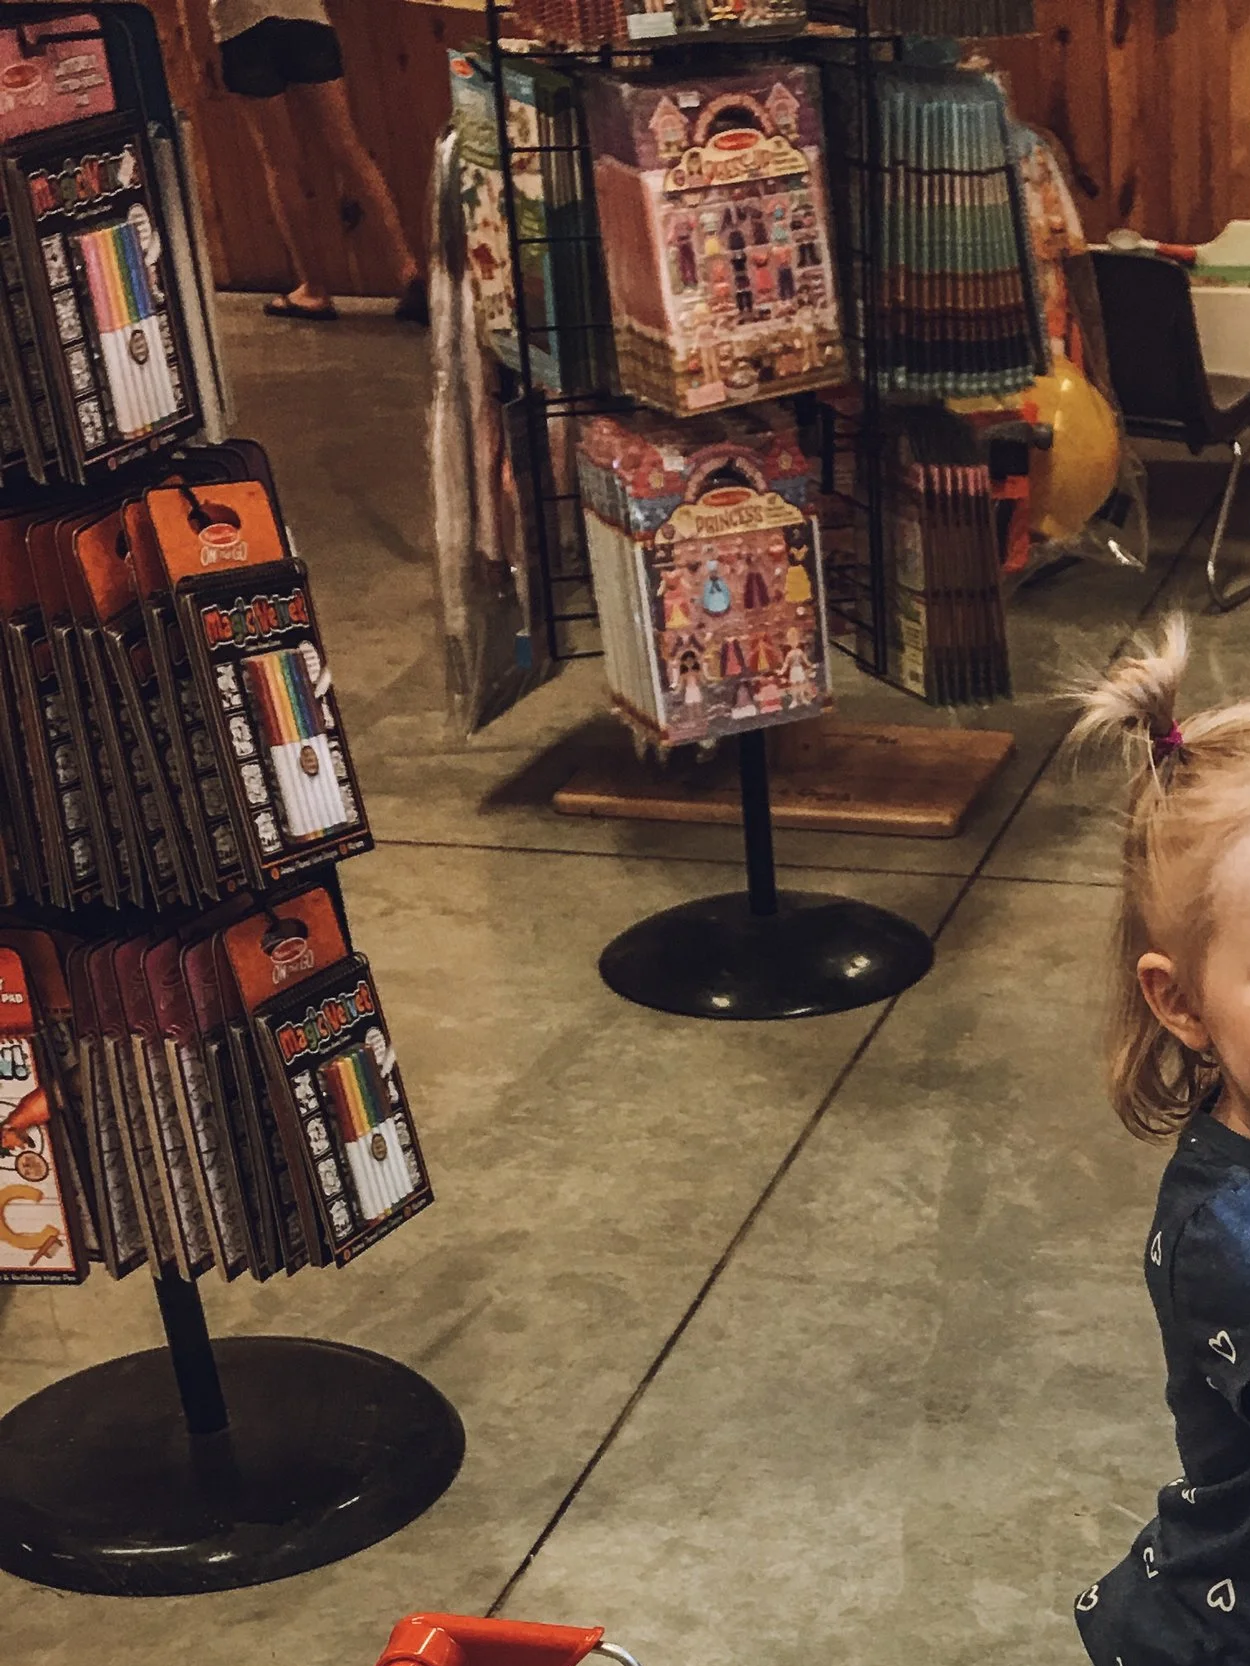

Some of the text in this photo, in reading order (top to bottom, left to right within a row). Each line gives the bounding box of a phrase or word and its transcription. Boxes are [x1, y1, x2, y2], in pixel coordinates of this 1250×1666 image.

[695, 504, 764, 534] PRINCESS
[201, 588, 309, 651] Magic Velvet
[275, 981, 375, 1065] Magic Velvet
